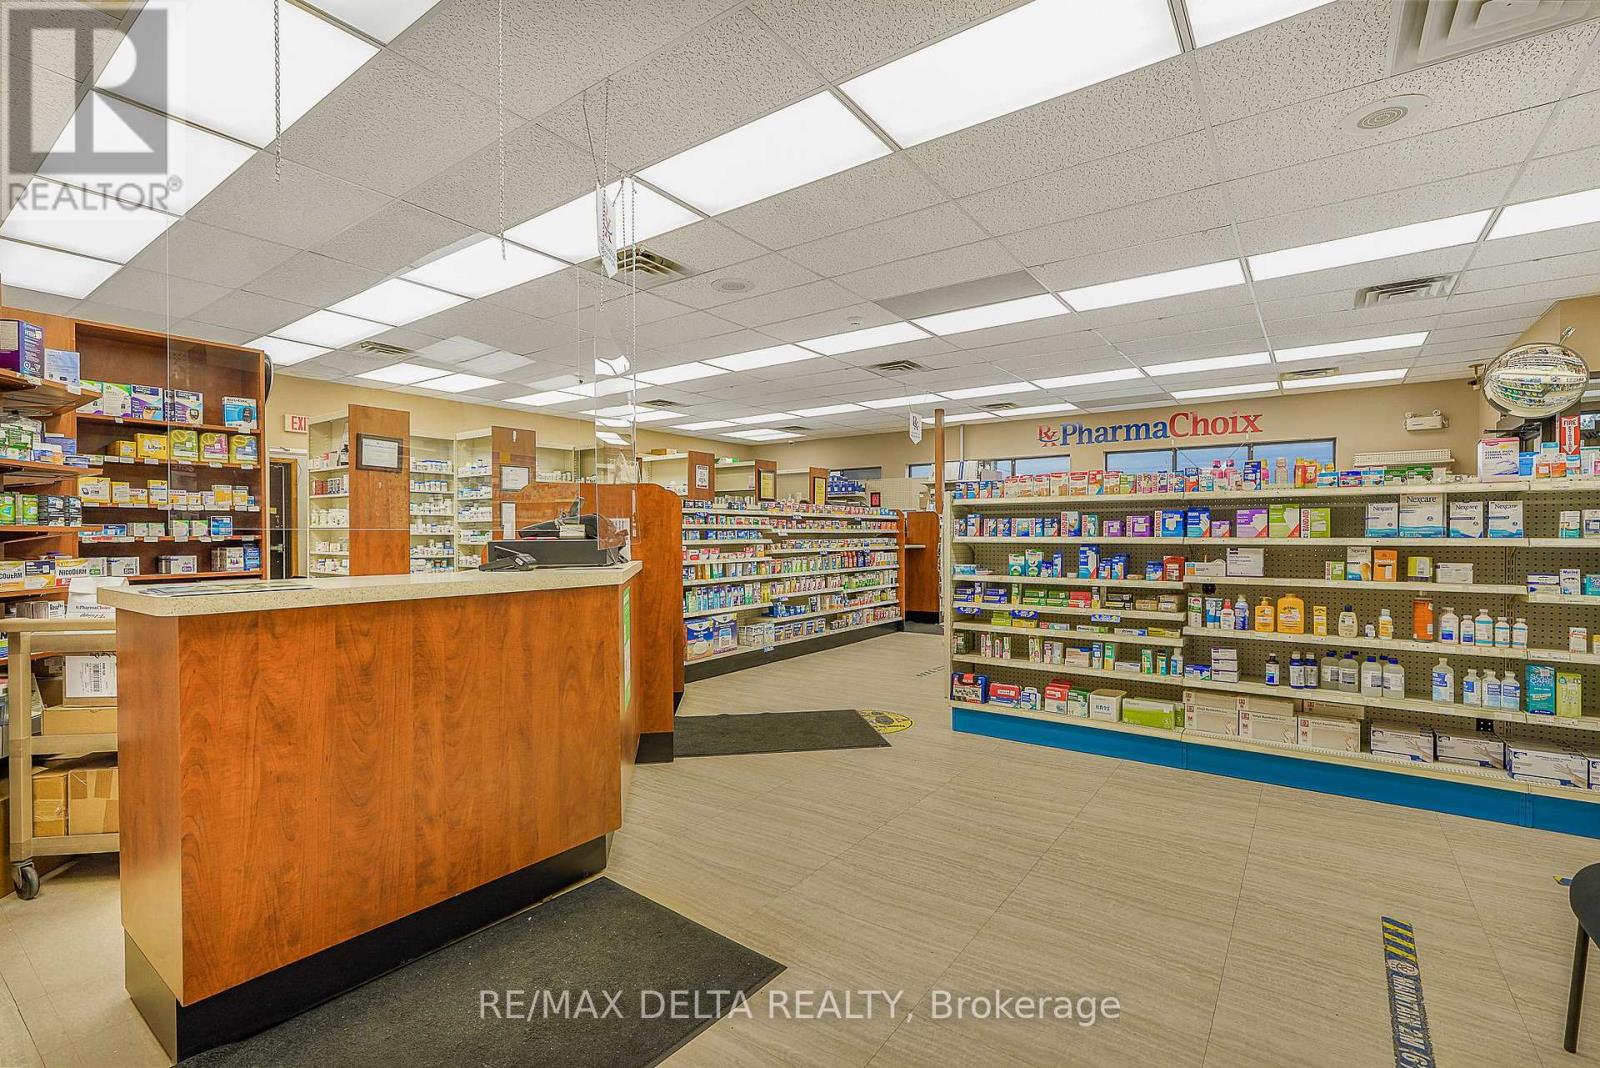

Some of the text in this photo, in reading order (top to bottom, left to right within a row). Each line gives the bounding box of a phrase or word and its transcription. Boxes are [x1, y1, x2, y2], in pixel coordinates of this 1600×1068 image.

[291, 415, 308, 431] EXI
[1060, 408, 1263, 446] PharmaChoix
[1406, 495, 1437, 505] Nexcare
[1393, 974, 1422, 1029] MAINTAIN
